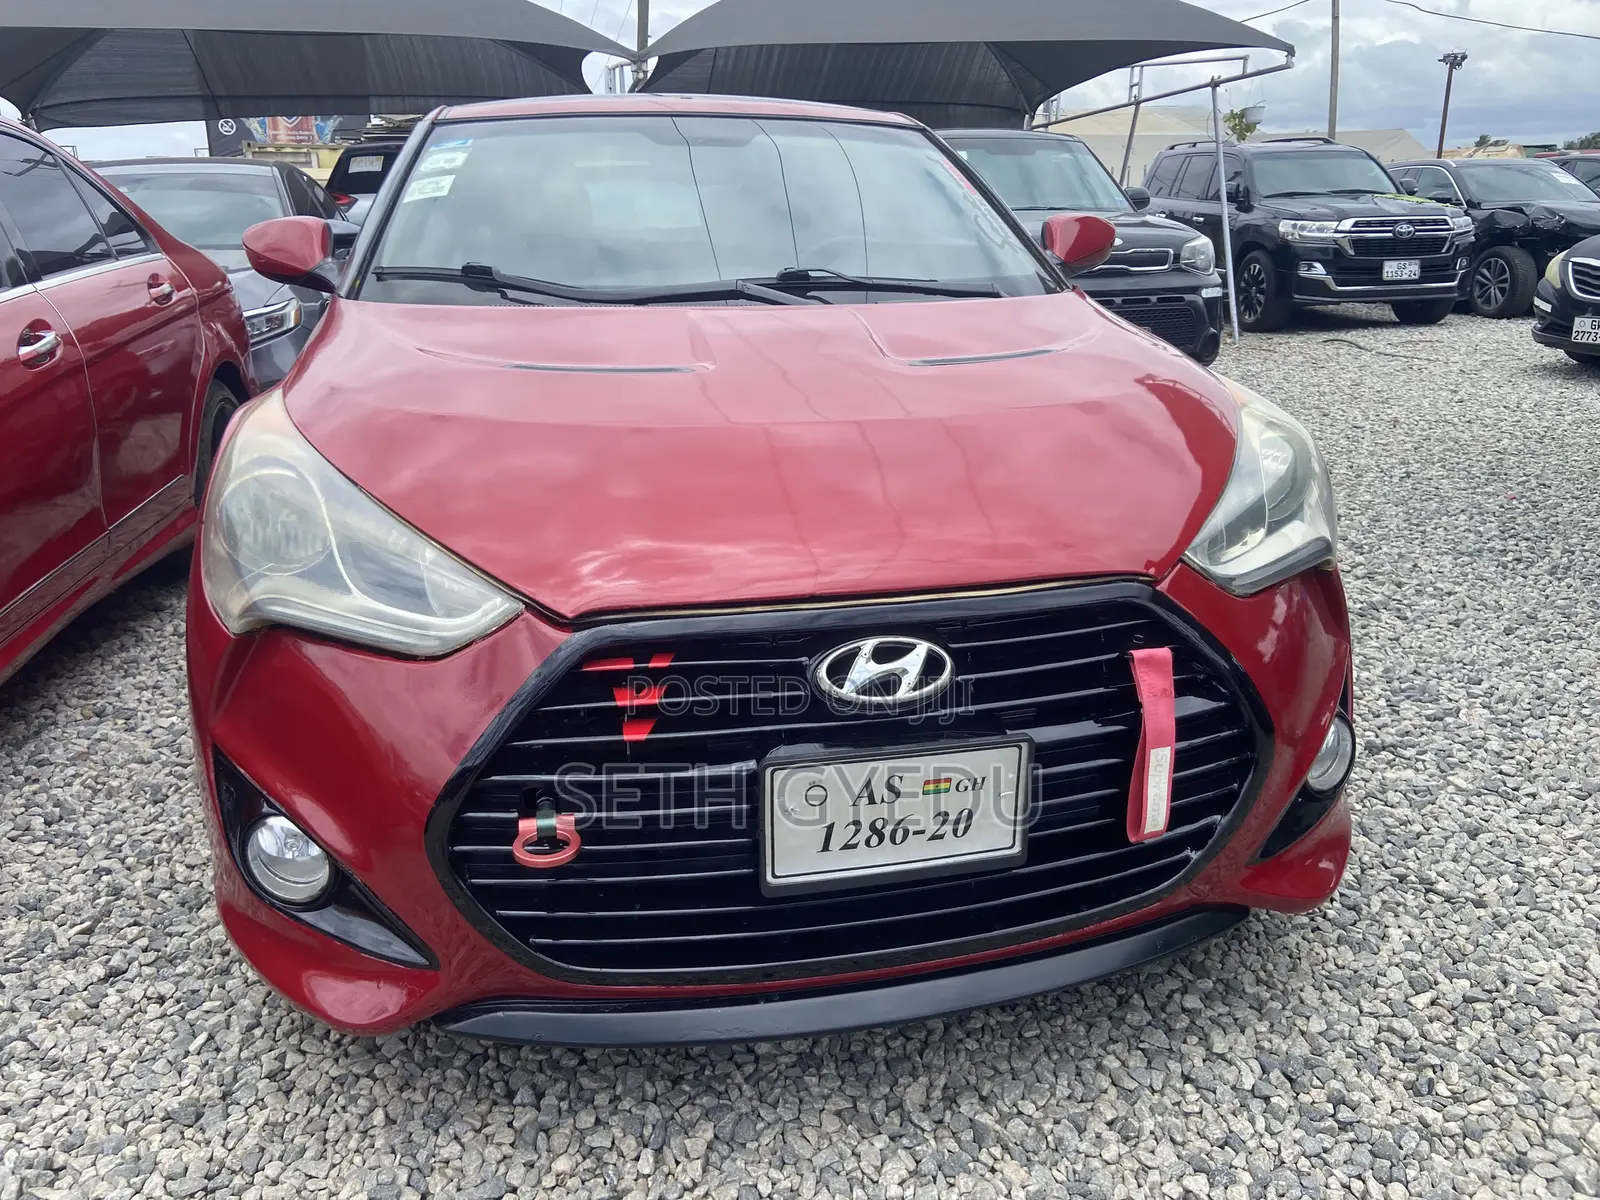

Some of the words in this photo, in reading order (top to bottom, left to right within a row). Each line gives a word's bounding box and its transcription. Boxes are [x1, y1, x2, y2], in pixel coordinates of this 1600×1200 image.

[1397, 262, 1407, 270] GS
[1573, 330, 1600, 342] 2773
[849, 774, 904, 807] AS
[955, 776, 987, 793] GH
[816, 807, 974, 854] 1286-20
